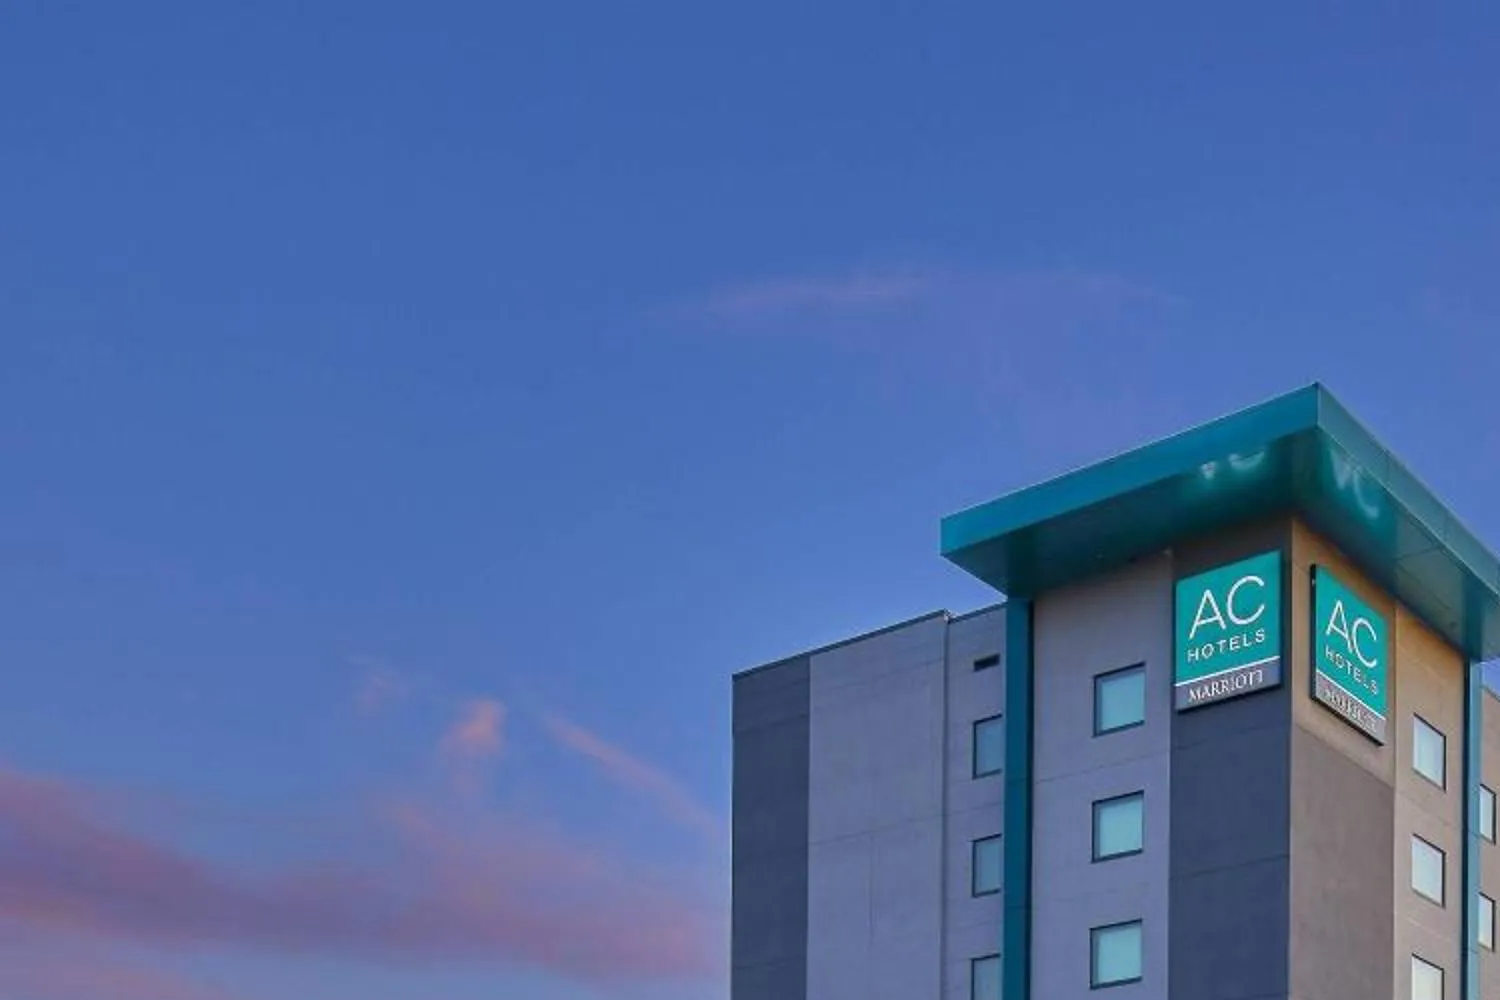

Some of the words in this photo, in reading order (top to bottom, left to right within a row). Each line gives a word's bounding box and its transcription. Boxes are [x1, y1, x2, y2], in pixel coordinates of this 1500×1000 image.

[1189, 575, 1265, 639] AC
[1187, 628, 1265, 663] HOTELS
[1325, 600, 1377, 668] AC
[1189, 669, 1264, 703] MARRIOTT
[1325, 645, 1378, 696] HOTELS
